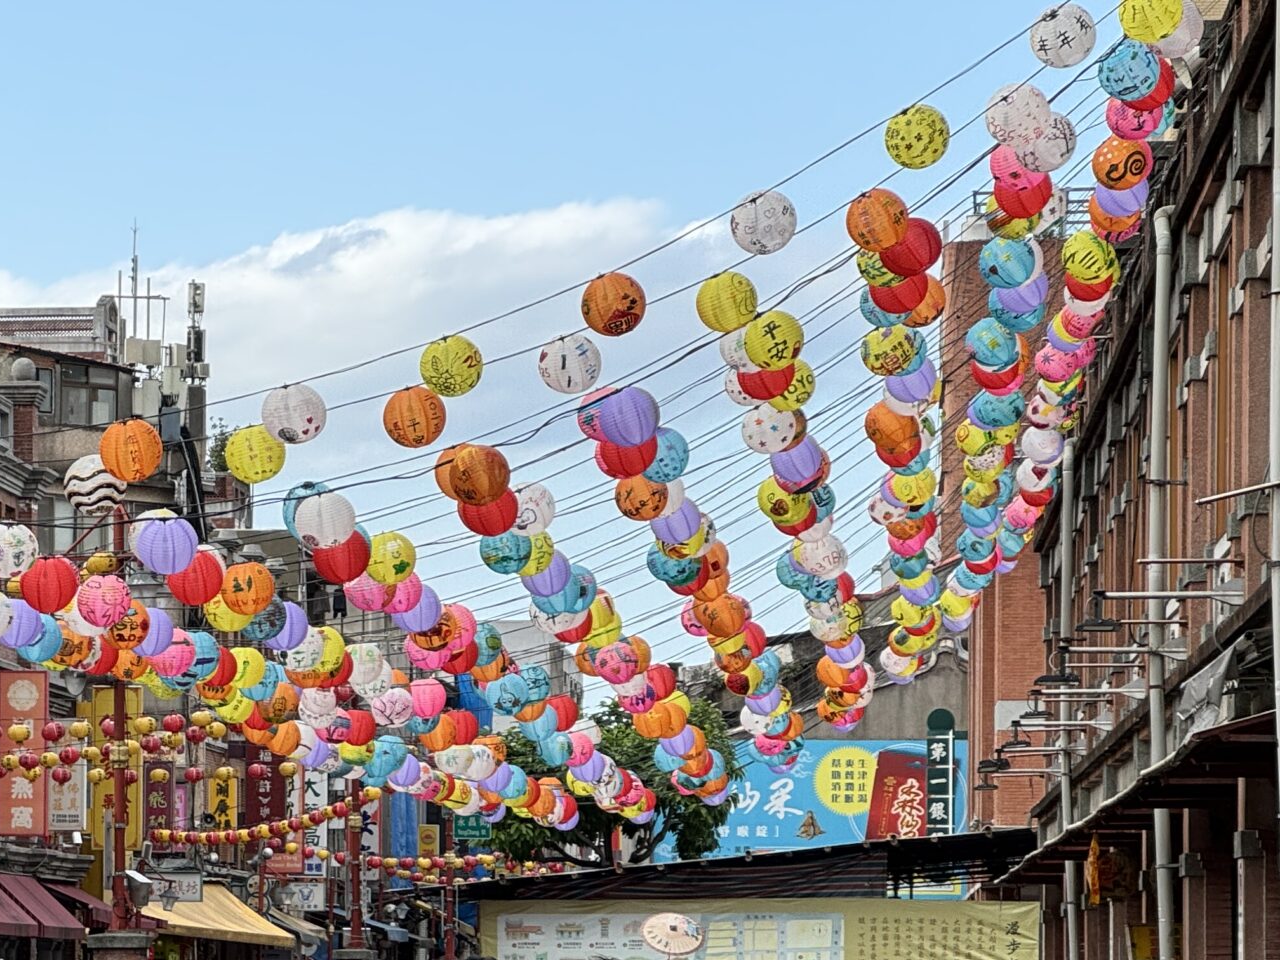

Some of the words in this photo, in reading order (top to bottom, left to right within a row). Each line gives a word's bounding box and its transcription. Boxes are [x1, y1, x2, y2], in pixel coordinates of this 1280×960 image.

[761, 320, 789, 362] 平安
[929, 743, 948, 837] 第一銀
